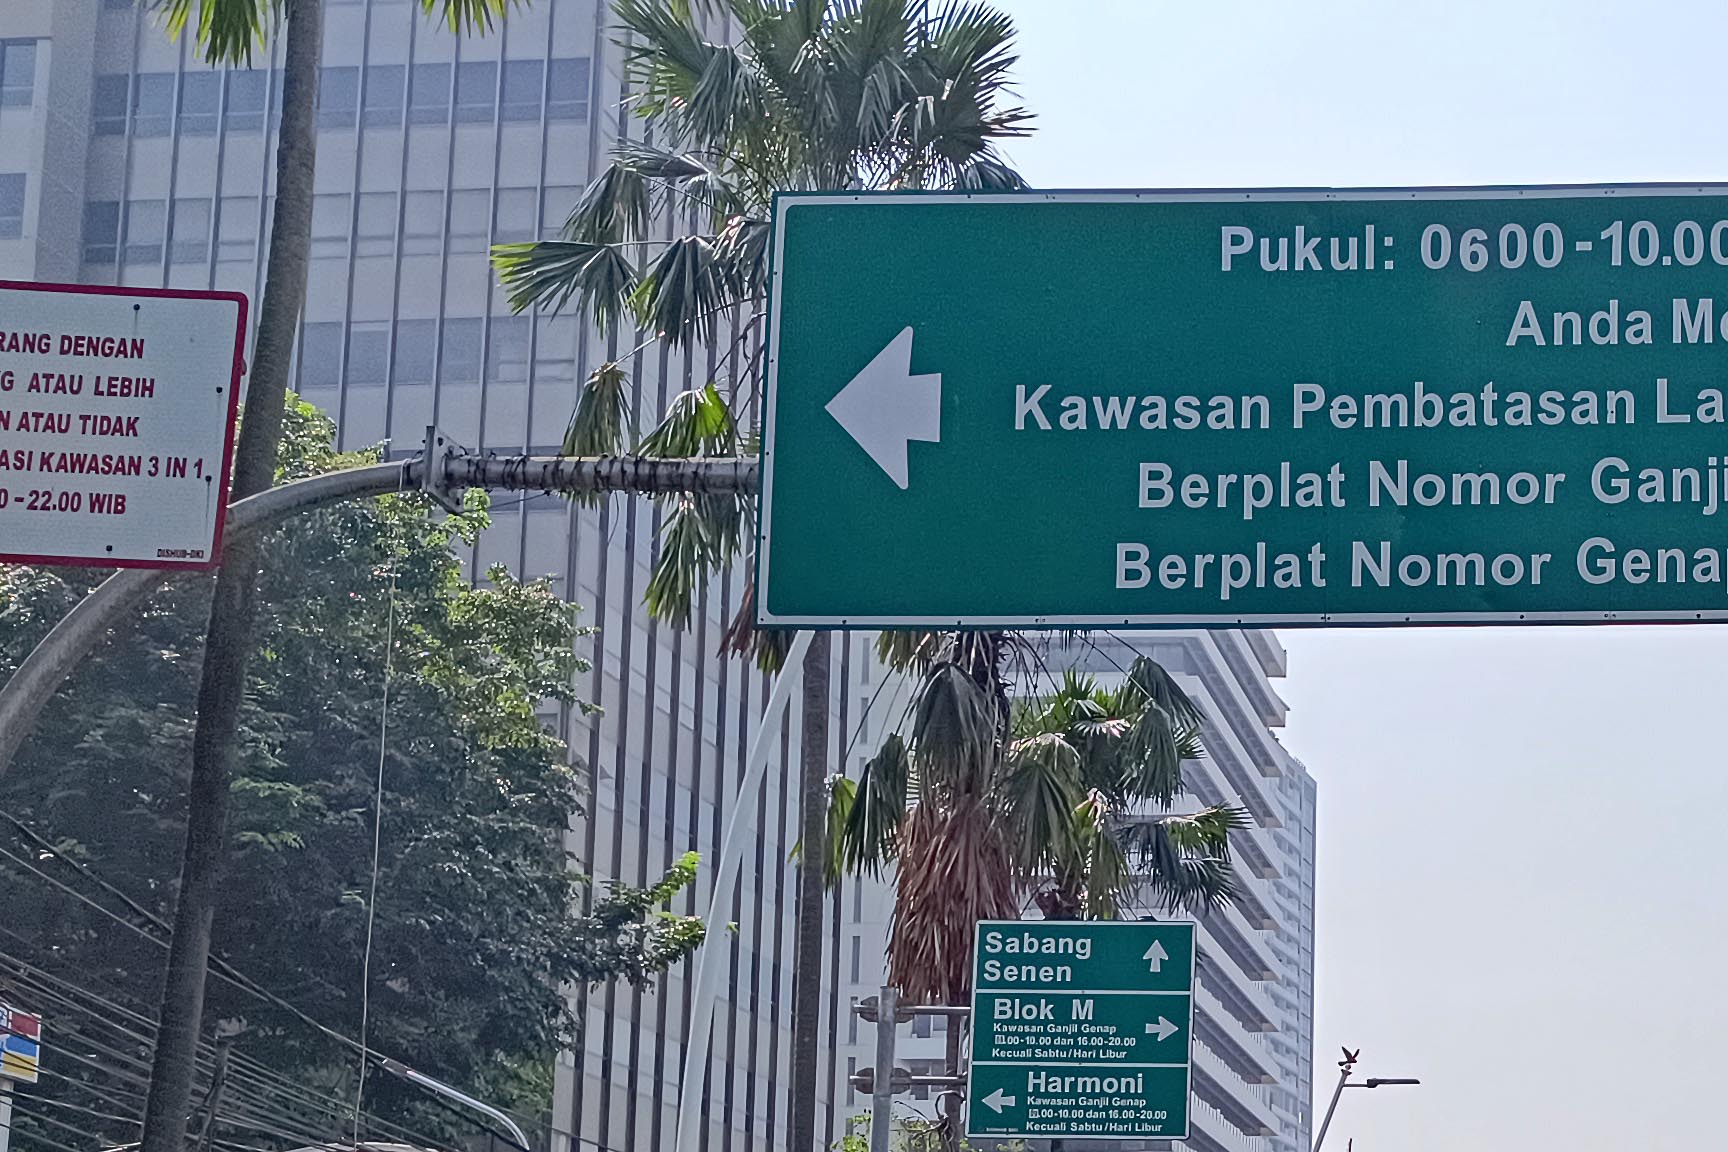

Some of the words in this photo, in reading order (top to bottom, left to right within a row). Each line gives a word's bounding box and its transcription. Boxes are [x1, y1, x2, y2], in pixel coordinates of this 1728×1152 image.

[1222, 225, 1393, 271] Pukul:
[1506, 300, 1652, 346] Anda
[59, 335, 144, 359] DENGAN
[28, 373, 82, 395] ATAU
[94, 376, 154, 398] LEBIH
[1015, 385, 1269, 430] Kawasan
[1294, 381, 1634, 428] Pembatasan
[16, 412, 70, 433] ATAU
[79, 415, 139, 437] TIDAK
[39, 451, 141, 475] KAWASAN
[148, 456, 158, 477] 3
[166, 457, 187, 478] IN
[194, 458, 203, 478] 1
[1139, 462, 1345, 520] Berplat
[1370, 460, 1565, 506] Nomor
[89, 493, 126, 514] WIB
[1116, 542, 1326, 600] Berplat
[1352, 541, 1551, 586] Nomor
[985, 932, 1091, 960] Sabang
[983, 960, 1072, 982] Senen
[994, 999, 1054, 1020] Blok
[1072, 1000, 1093, 1020] M
[993, 1023, 1043, 1032] Kawasan
[1047, 1024, 1077, 1034] Ganjil
[1082, 1024, 1116, 1034] Genap
[1054, 1037, 1074, 1045] dan
[1028, 1072, 1143, 1093] Harmoni
[1027, 1097, 1075, 1105] Kawasan
[1079, 1097, 1109, 1108] Ganjil
[1112, 1098, 1146, 1107] Genap
[1086, 1110, 1106, 1119] dan
[1135, 1123, 1162, 1132] Libur
